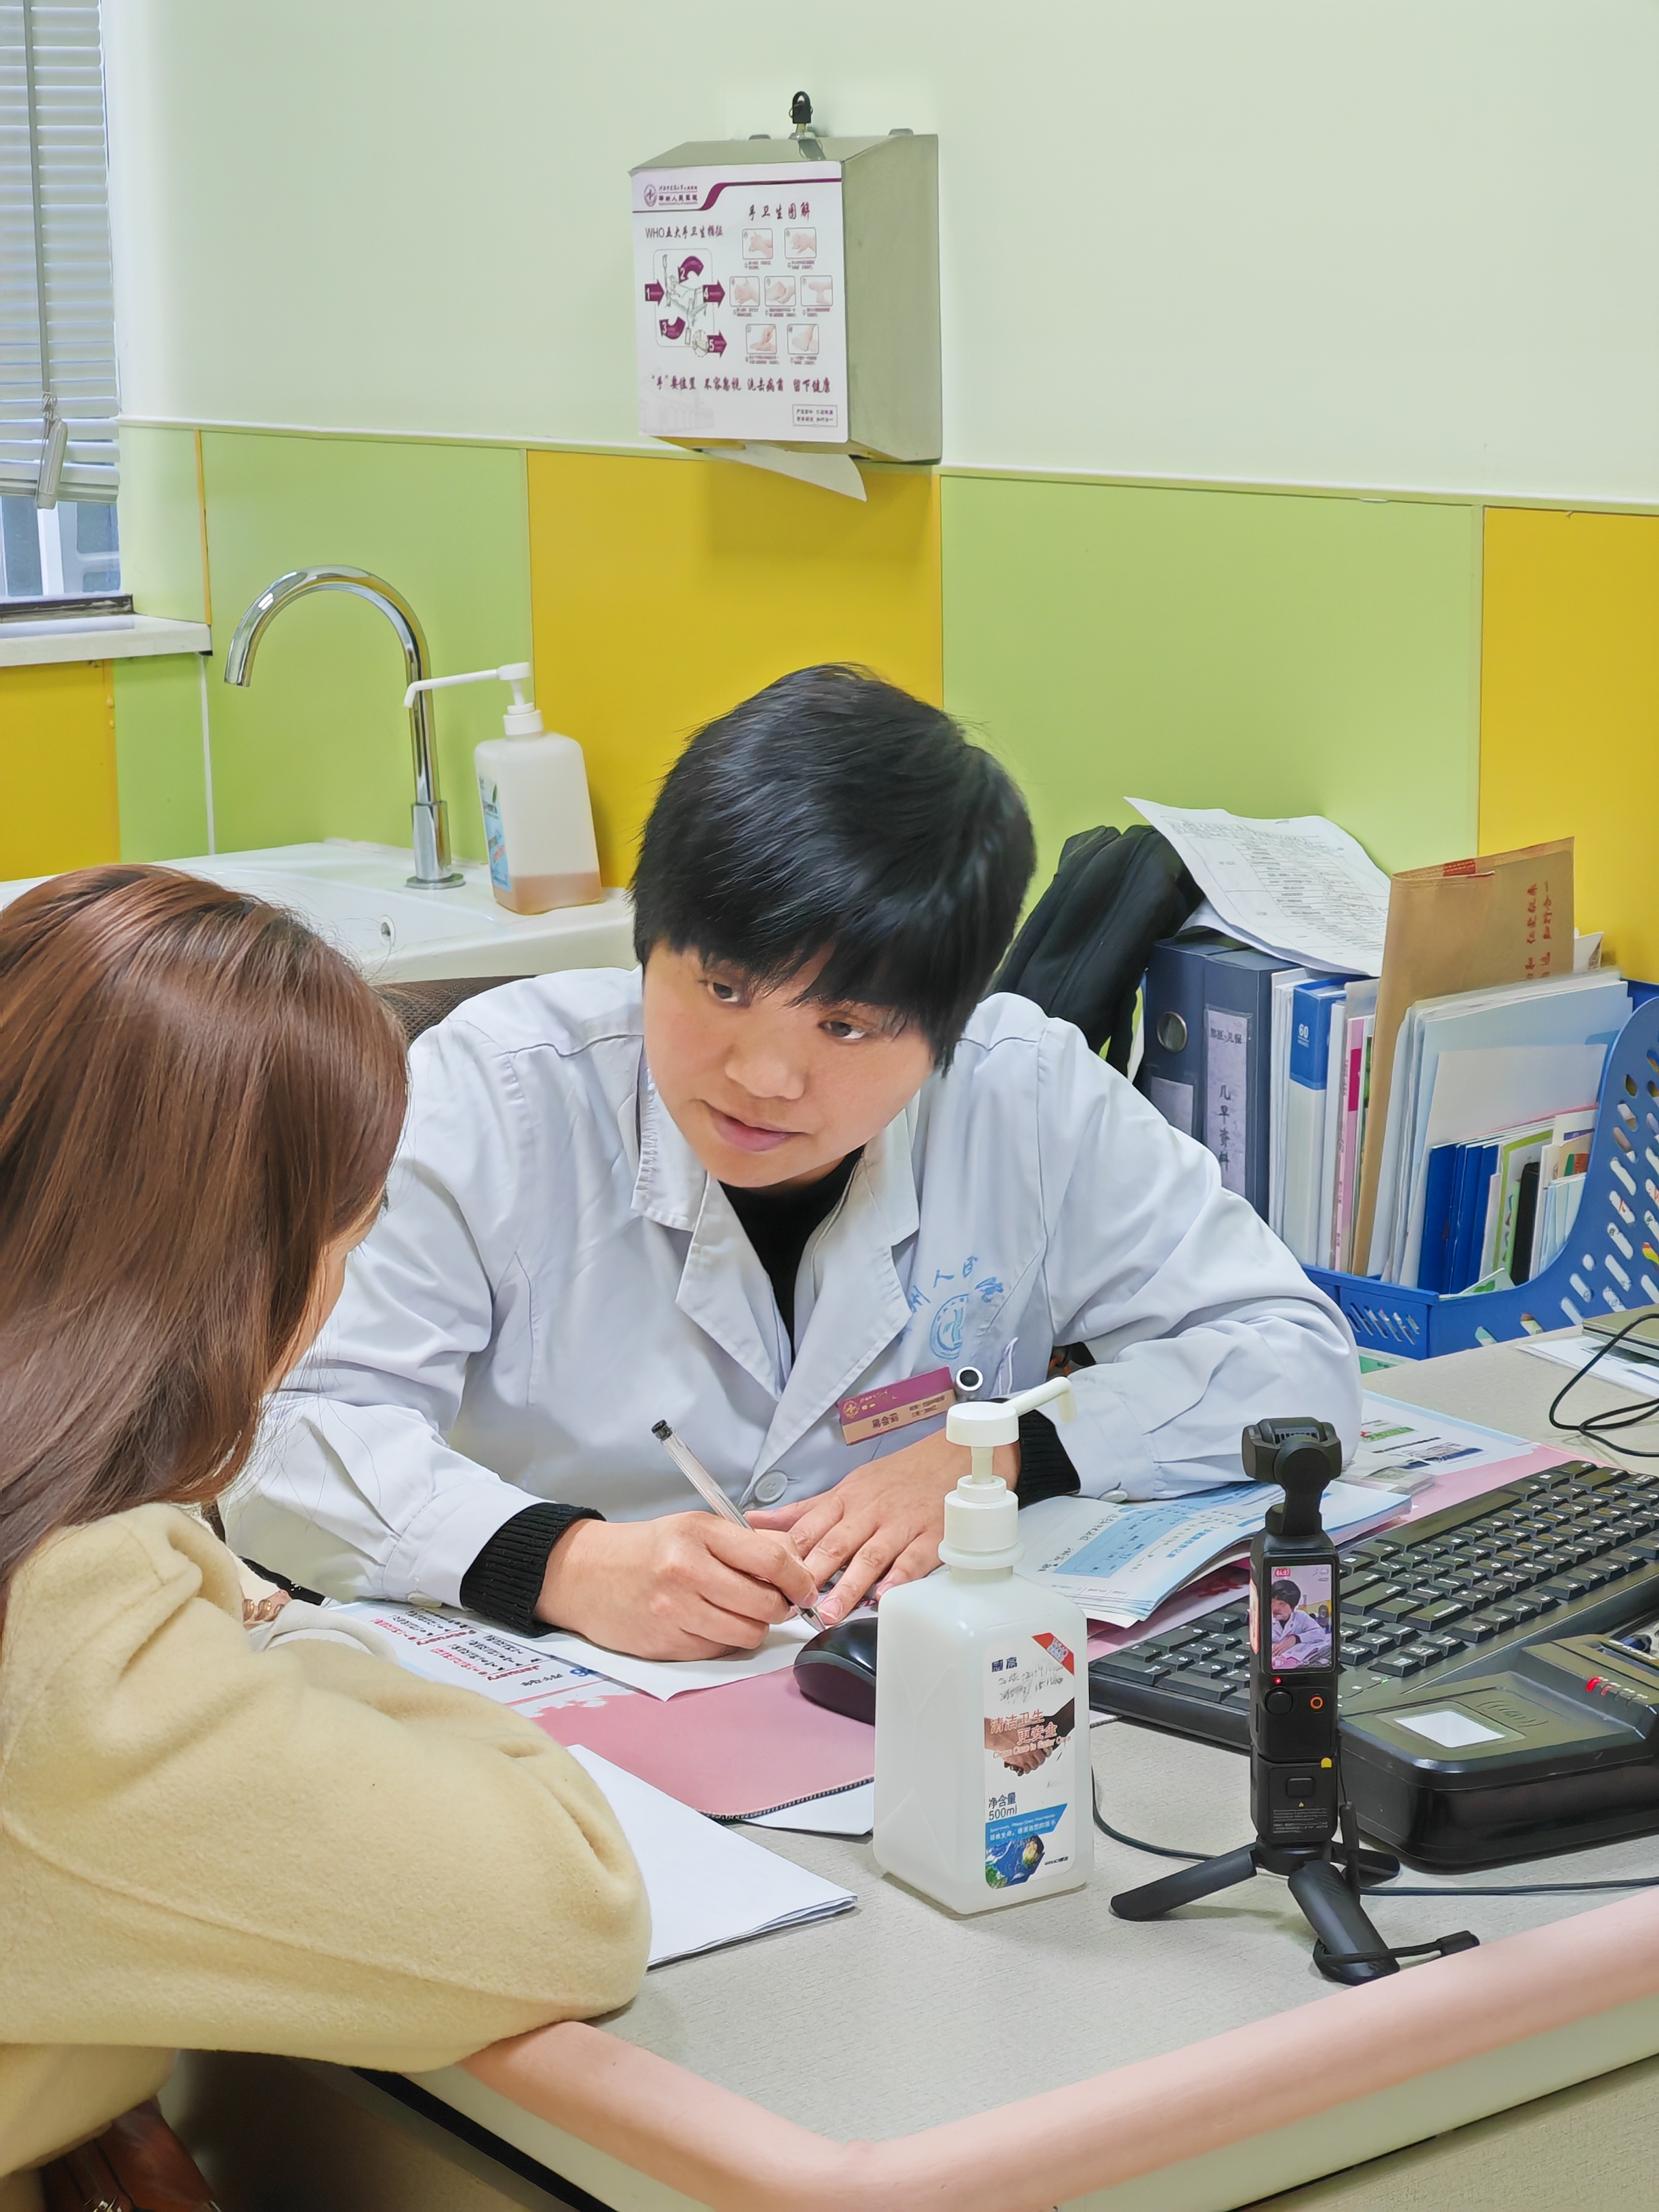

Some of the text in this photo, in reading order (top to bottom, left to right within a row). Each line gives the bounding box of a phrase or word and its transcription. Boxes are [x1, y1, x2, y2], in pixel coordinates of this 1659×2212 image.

[748, 202, 811, 221] 手卫生图解
[680, 267, 686, 281] 2
[646, 287, 651, 300] 1
[703, 287, 709, 300] 4
[661, 321, 668, 334] 3
[709, 339, 715, 351] 5
[793, 377, 831, 394] 留下健康
[1298, 1023, 1309, 1039] 60
[990, 1708, 1045, 1734] 清洁卫生
[1017, 1721, 1058, 1746] 更安全
[989, 1792, 1017, 1809] 净含量
[989, 1804, 1017, 1820] 500ml
